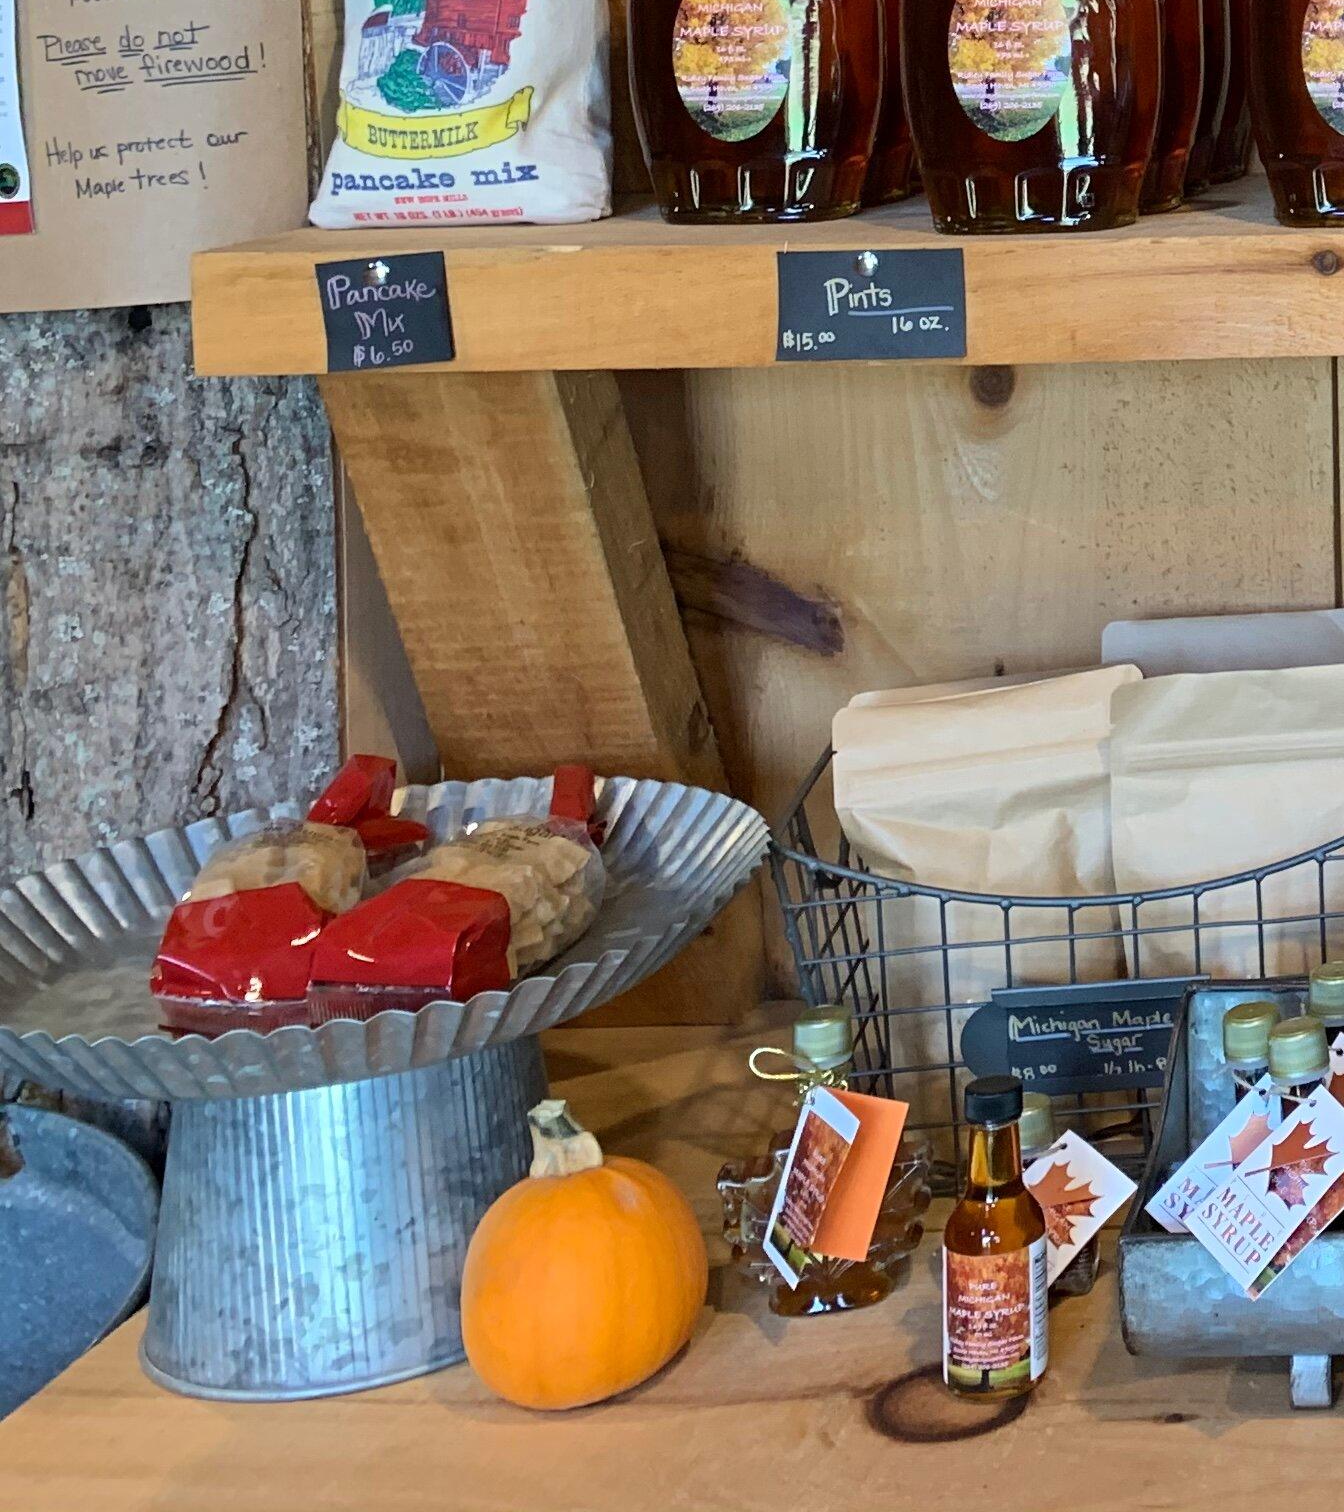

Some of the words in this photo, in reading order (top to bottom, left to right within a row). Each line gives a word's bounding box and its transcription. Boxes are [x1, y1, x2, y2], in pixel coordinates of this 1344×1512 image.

[36, 35, 107, 61] Please
[118, 25, 145, 49] do
[155, 21, 210, 46] not
[956, 22, 1007, 33] MAPLE
[1011, 22, 1063, 35] SYRUP
[75, 67, 128, 85] move
[45, 136, 84, 169] Help
[90, 145, 108, 159] us
[117, 129, 193, 165] protect
[207, 131, 248, 146] our
[366, 120, 480, 151] BUTTERMILK
[75, 178, 125, 200] Maple
[331, 167, 456, 195] pancake
[471, 162, 539, 186] mix
[327, 275, 436, 310] Pancake
[823, 278, 893, 316] Pints
[892, 316, 913, 334] 16
[1009, 1010, 1100, 1042] Michigan
[1112, 1010, 1171, 1029] Maple
[1086, 1033, 1144, 1055] Sugar
[1202, 1203, 1261, 1265] SYRUP
[1217, 1187, 1274, 1252] MAPLE
